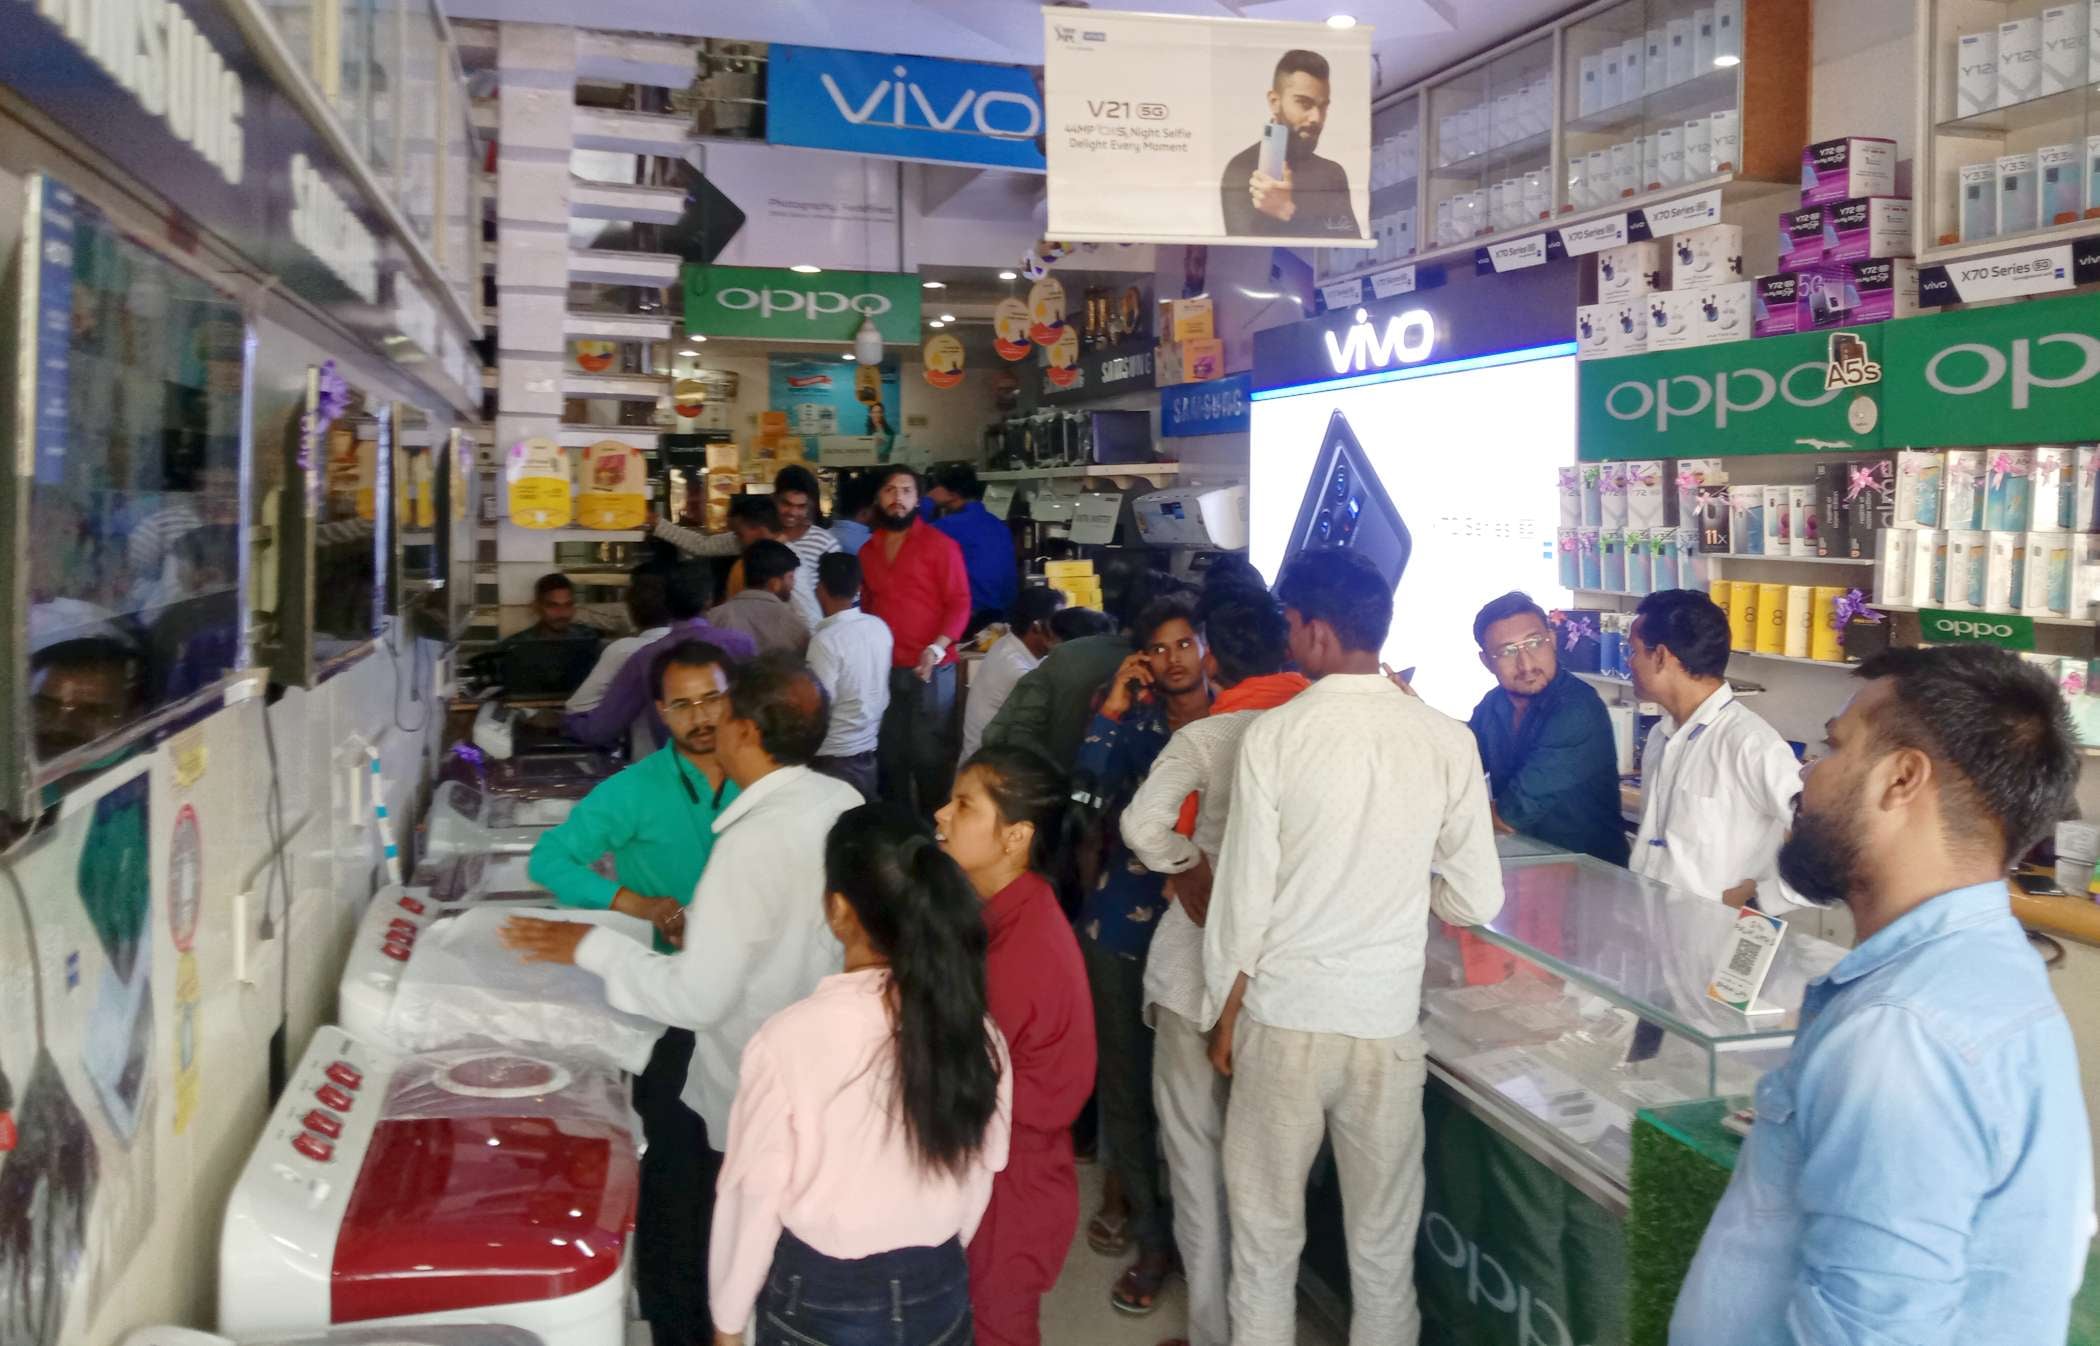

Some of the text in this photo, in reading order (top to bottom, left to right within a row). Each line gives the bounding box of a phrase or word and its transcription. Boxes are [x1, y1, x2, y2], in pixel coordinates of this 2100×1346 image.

[820, 65, 1040, 140] vivo
[1088, 100, 1166, 119] V21 5G
[1069, 138, 1189, 152] Delight Every Moment
[2080, 255, 2100, 266] viv
[1961, 267, 1988, 282] X70
[1991, 263, 2031, 278] Series
[1924, 281, 1948, 290] vivo
[716, 286, 892, 320] oppo
[1326, 308, 1435, 373] vivo
[1827, 360, 1881, 388] A5s
[1605, 361, 1842, 433] oppo
[1705, 529, 1728, 545] 11x
[1772, 609, 1784, 626] 8
[1936, 619, 2014, 638] oppo
[1601, 666, 1631, 680] viv
[1425, 1212, 1590, 1346] opp
